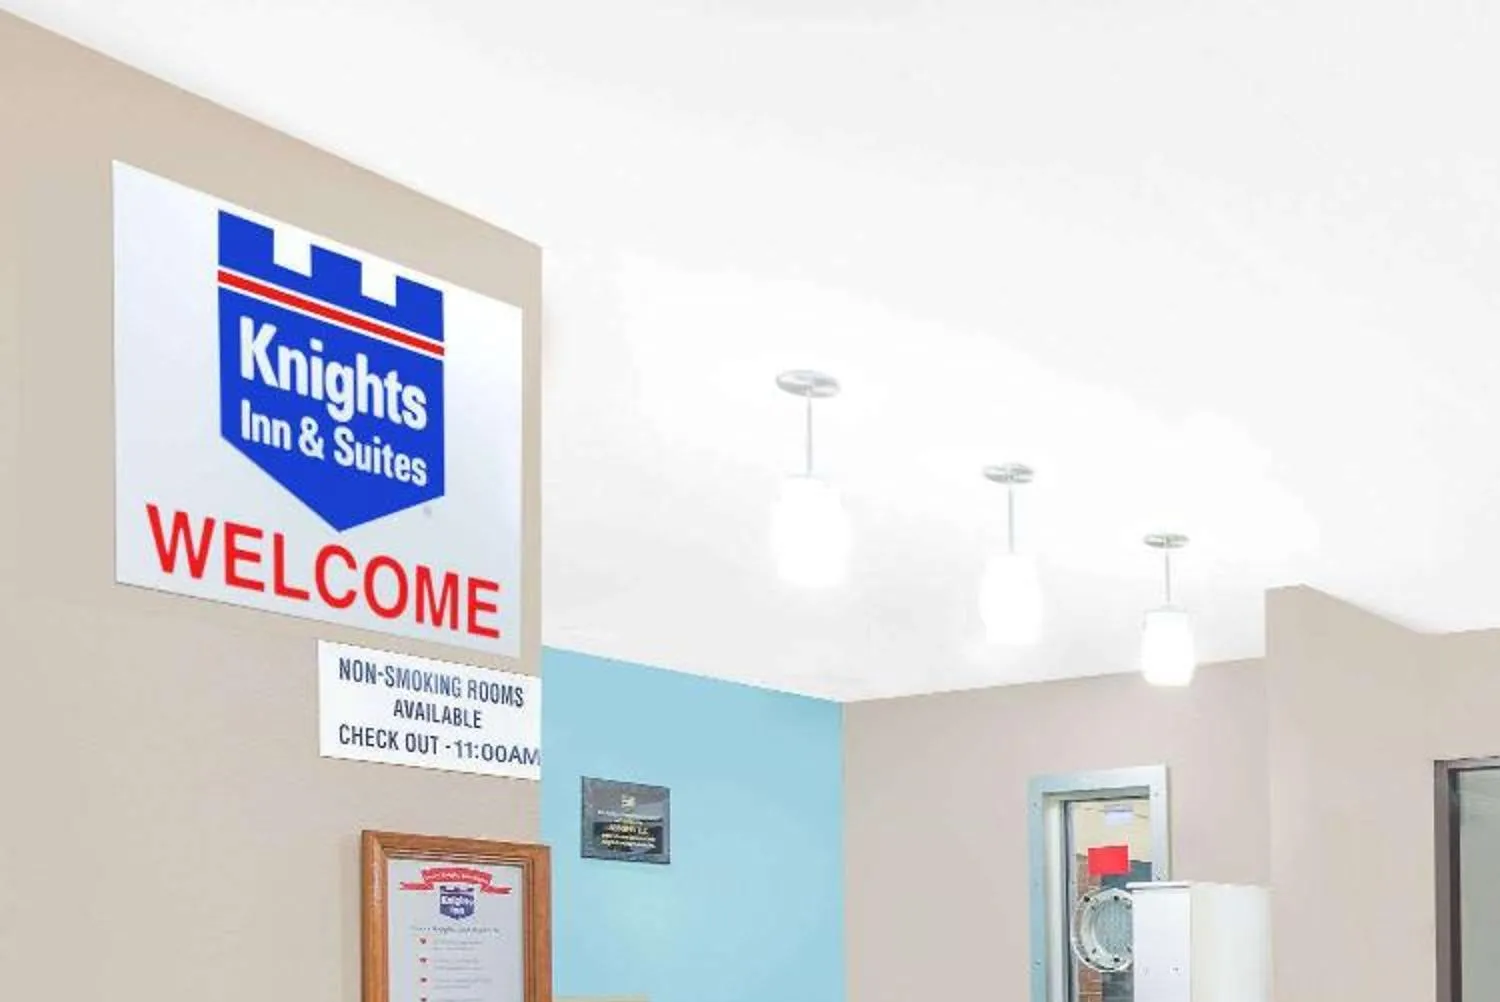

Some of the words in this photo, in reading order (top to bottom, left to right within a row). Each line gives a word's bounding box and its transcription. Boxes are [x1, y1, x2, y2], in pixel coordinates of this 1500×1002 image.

[240, 316, 427, 429] Knights
[240, 400, 292, 451] Inn
[298, 415, 325, 460] &
[334, 427, 427, 486] Suites
[146, 504, 500, 639] WELCOME
[339, 657, 462, 699] NON-SMOKING
[467, 679, 524, 708] ROOMS
[393, 699, 481, 728] AVAILABLE
[339, 724, 399, 751] CHECK
[405, 733, 439, 755] OUT
